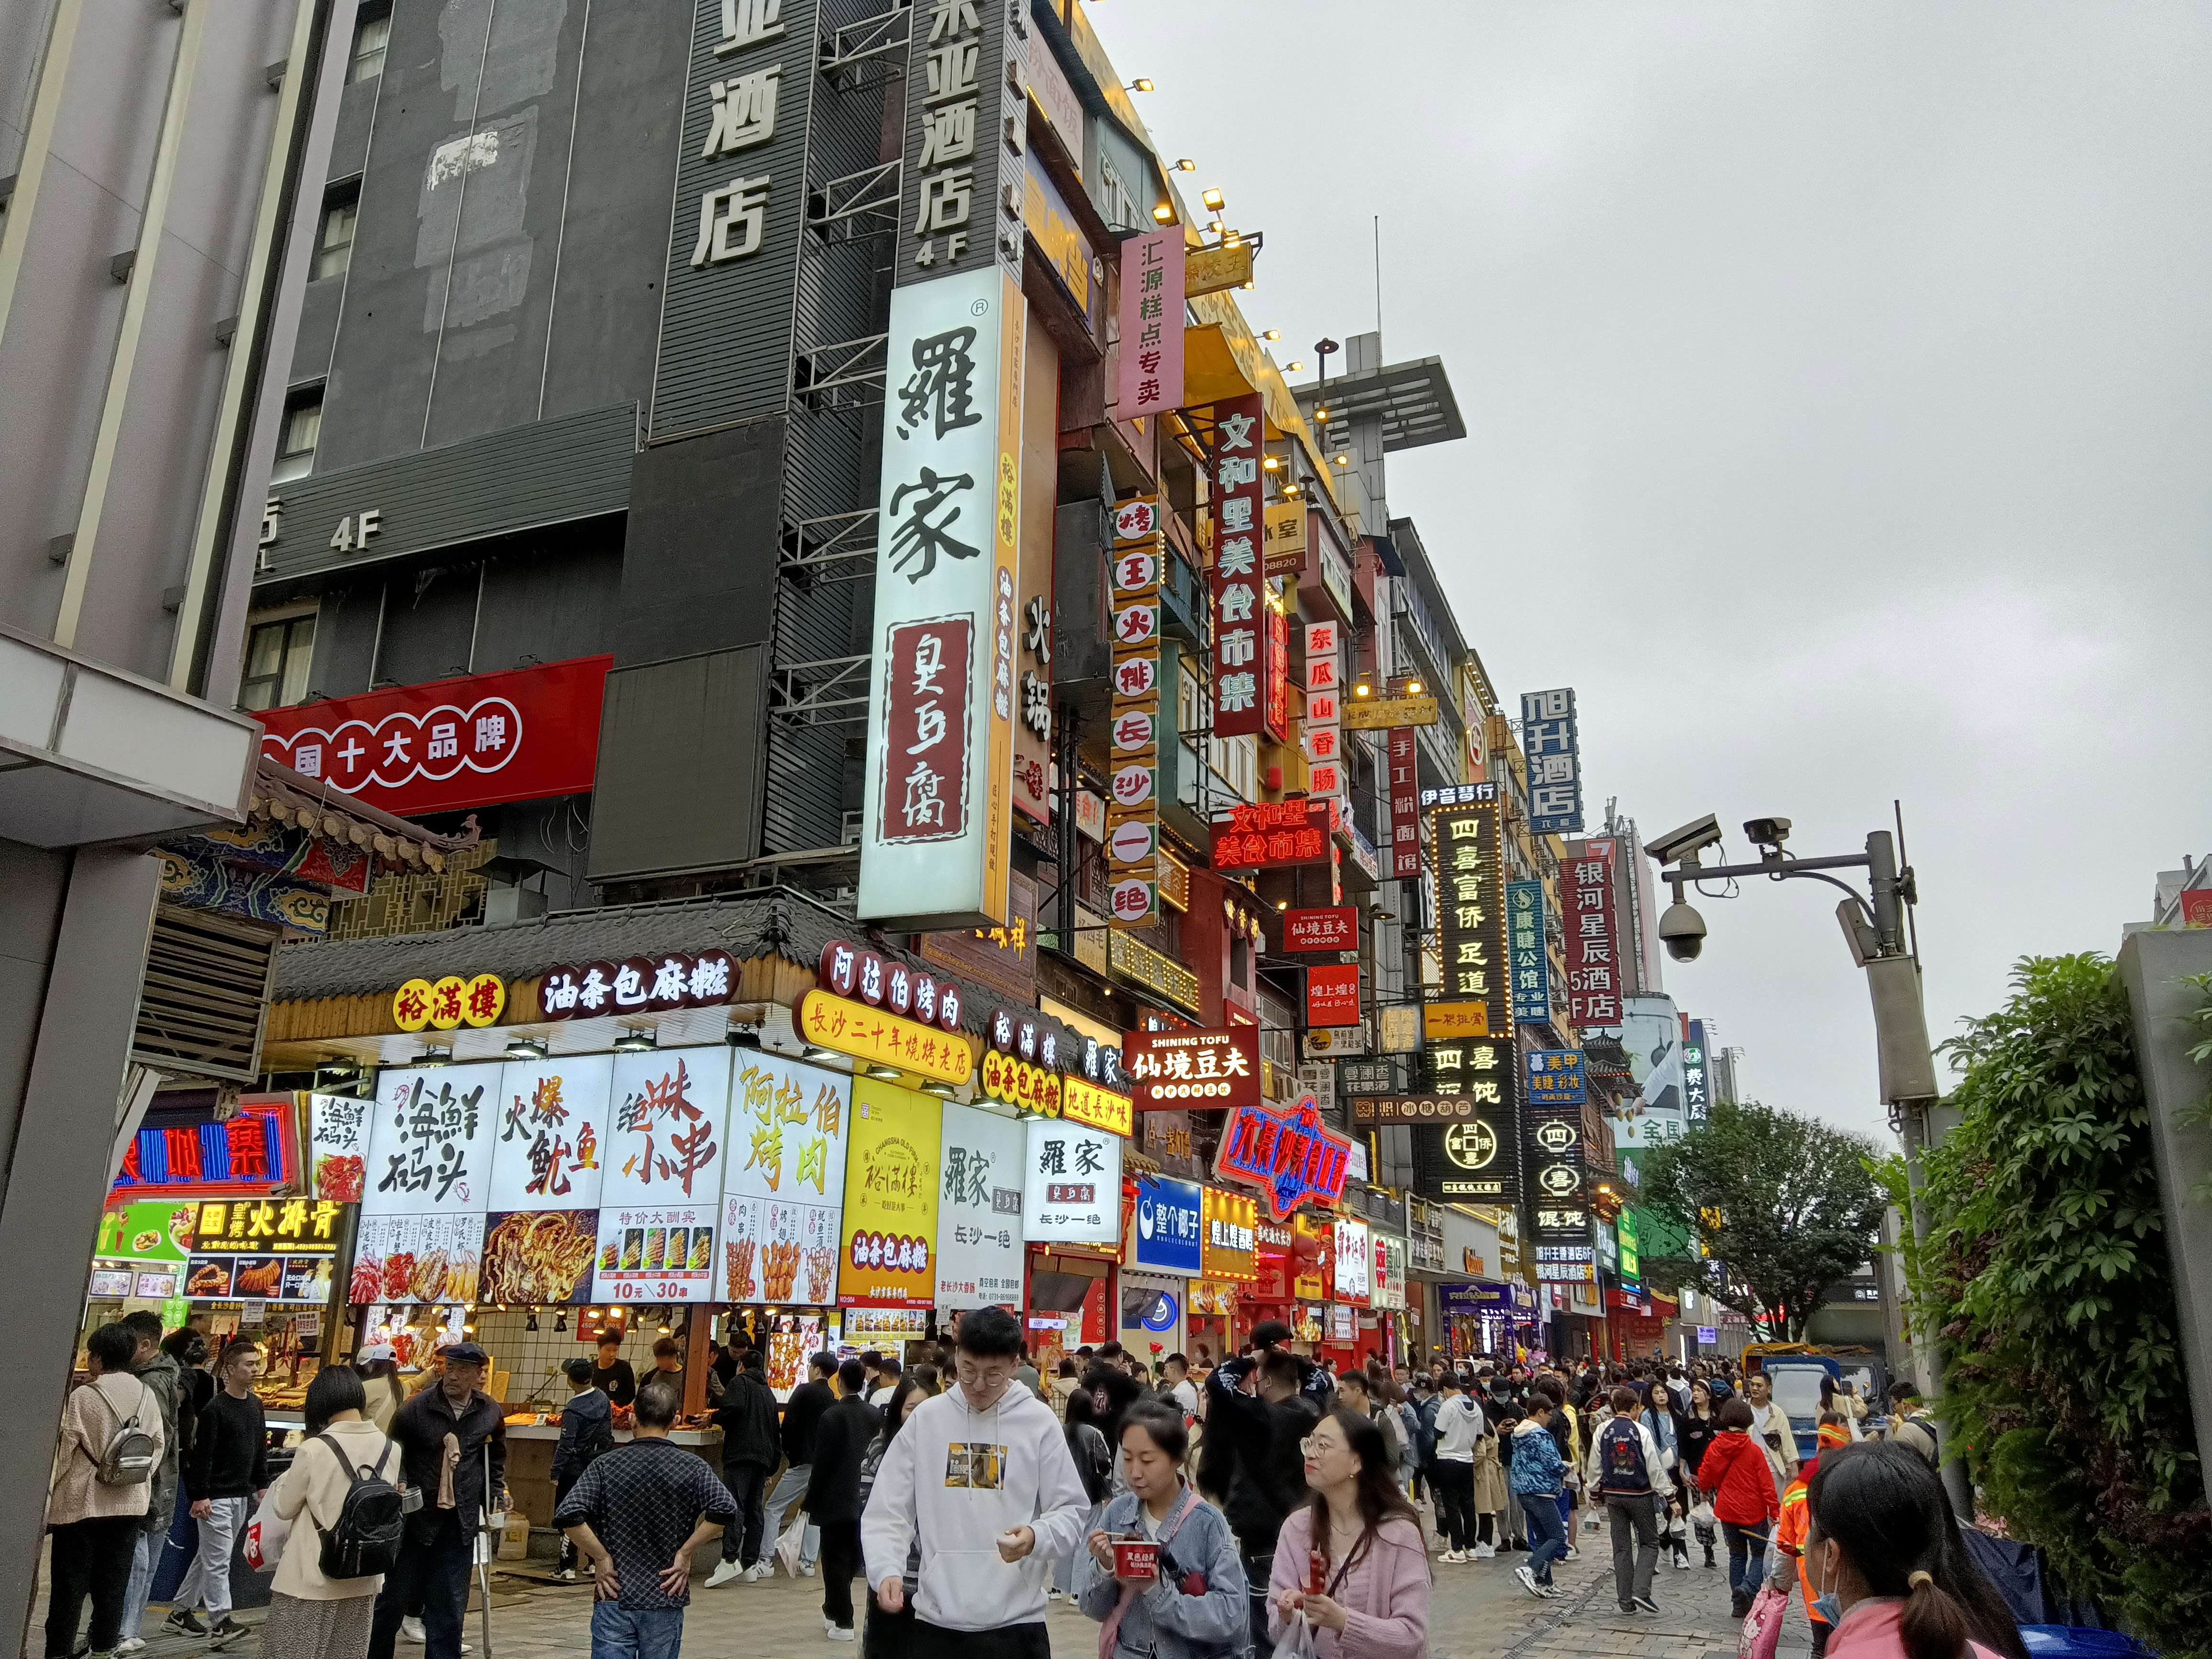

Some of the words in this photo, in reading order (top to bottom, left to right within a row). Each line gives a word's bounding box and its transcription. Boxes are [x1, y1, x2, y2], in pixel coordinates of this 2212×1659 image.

[690, 0, 785, 266] 亚酒店
[1138, 240, 1164, 405] 汇源糕点专卖
[888, 326, 982, 585] 羅家
[330, 509, 380, 552] 4F
[1218, 413, 1256, 712] 文和里美食市集
[1030, 595, 1051, 742] 火锅
[1310, 628, 1335, 793] 东瓜山香肠
[263, 715, 506, 778] 国十大品牌
[902, 633, 946, 827] 臭豆腐
[1526, 689, 1576, 817] 旭升酒店
[1421, 783, 1494, 806] 伊音琴行
[1228, 798, 1307, 833] 文和里
[1215, 828, 1322, 865] 美食市集
[1449, 819, 1490, 995] 四喜富侨足道
[1291, 920, 1349, 936] 仙境豆夫
[1575, 862, 1615, 1019] 银河星辰酒店
[833, 946, 959, 1028] 阿拉伯烤肉
[1310, 983, 1348, 996] 煌上煌
[1513, 992, 1544, 1002] 专业
[1428, 1012, 1484, 1027] 一根排骨
[1151, 1037, 1196, 1048] SHINING
[1200, 1035, 1229, 1045] TOFU
[1435, 1046, 1499, 1070] 四喜
[1084, 1039, 1118, 1084] 羅家
[1132, 1048, 1251, 1080] 仙境豆夫
[1547, 1054, 1578, 1071] 美甲
[500, 1075, 570, 1143] 火爆
[739, 1064, 841, 1139] 阿拉伯
[1068, 1090, 1128, 1129] 地道長沙味
[1403, 1102, 1471, 1115] 冰糖葫芦
[875, 1136, 900, 1155] CHANGSHA
[900, 1138, 909, 1150] OLD
[1449, 1137, 1462, 1150] 富
[1479, 1137, 1493, 1150] 侨
[1462, 1124, 1477, 1134] 四
[1545, 1128, 1568, 1142] 四
[1642, 1119, 1681, 1141] 全国
[378, 1144, 467, 1202] 码头
[621, 1120, 717, 1198] 小串
[743, 1124, 827, 1195] 烤肉
[1039, 1139, 1105, 1177] 羅家
[1462, 1152, 1479, 1165] 喜
[943, 1145, 991, 1209] 羅家
[1052, 1185, 1090, 1202] 臭豆腐
[1548, 1171, 1572, 1188] 喜
[247, 1200, 339, 1239] 火排骨
[619, 1210, 697, 1225] 特价大酬宾
[1040, 1214, 1101, 1225] 长沙一绝
[1156, 1202, 1198, 1239] 整个椰子
[1537, 1210, 1587, 1228] 馄饨
[954, 1224, 1010, 1249] 长沙一绝
[940, 1280, 975, 1294] 老长沙大香肠
[979, 1277, 998, 1289] 真空包装
[1001, 1279, 1019, 1289] 全国包邮
